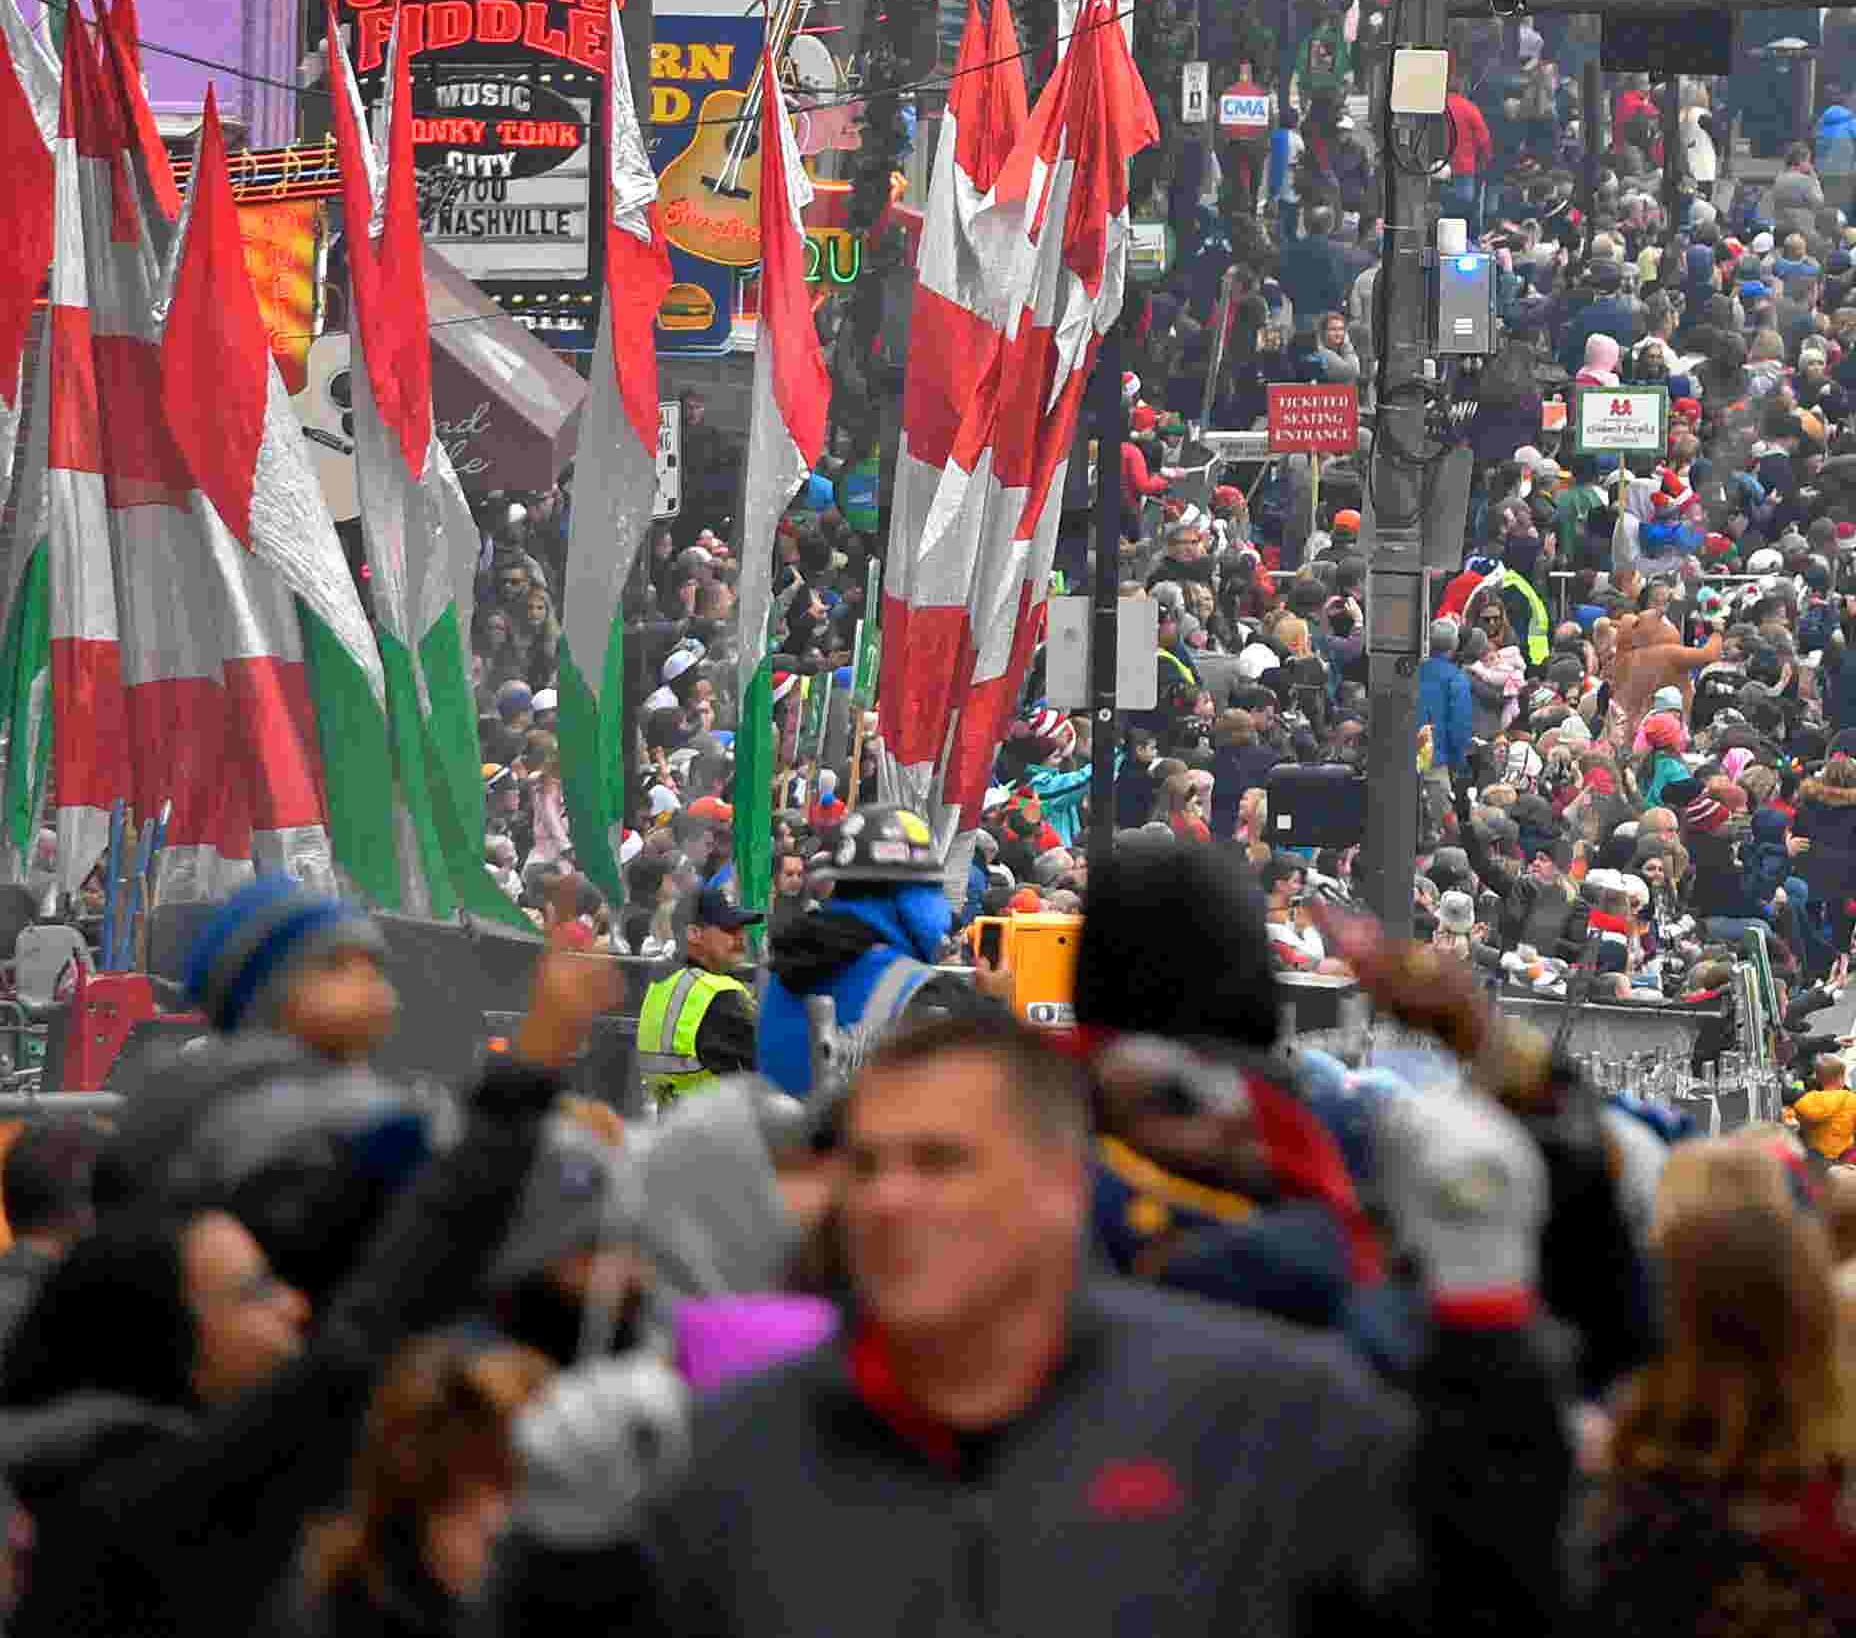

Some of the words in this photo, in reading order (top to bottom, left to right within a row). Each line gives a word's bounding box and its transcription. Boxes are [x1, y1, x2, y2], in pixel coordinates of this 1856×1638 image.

[357, 0, 609, 75] FIDDLE
[435, 81, 532, 113] MUSIC
[1221, 98, 1266, 118] CMA
[411, 118, 486, 145] ONKY
[496, 119, 579, 147] TONK
[446, 151, 517, 178] CITY
[438, 209, 573, 237] NASHVILLE
[1279, 394, 1350, 409] TICKETED
[1282, 412, 1345, 426] SEATING
[1273, 426, 1350, 443] ENTRANCE
